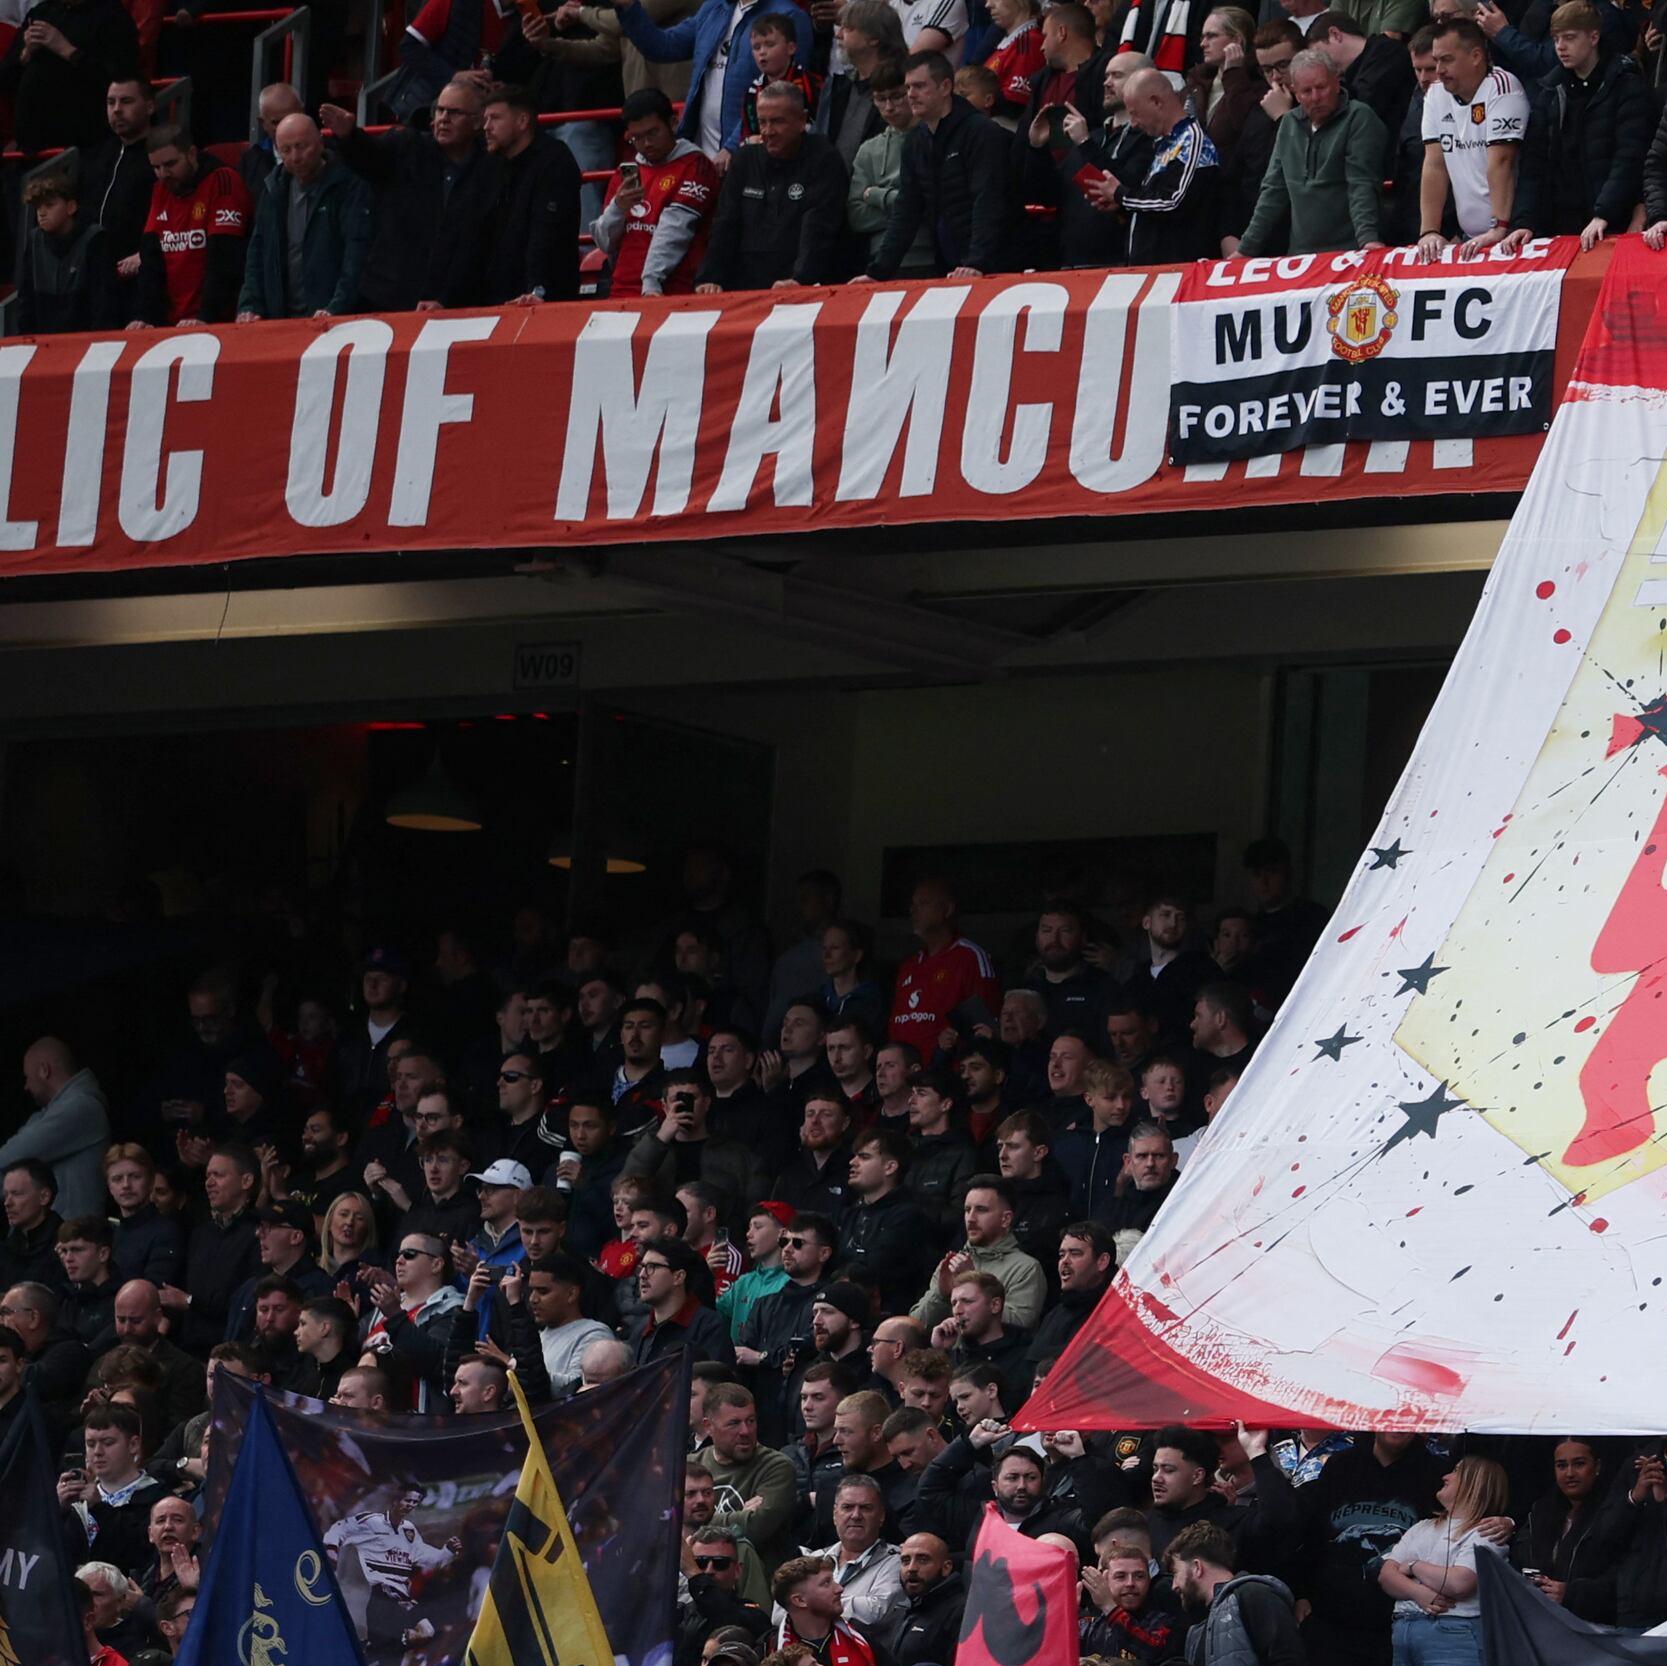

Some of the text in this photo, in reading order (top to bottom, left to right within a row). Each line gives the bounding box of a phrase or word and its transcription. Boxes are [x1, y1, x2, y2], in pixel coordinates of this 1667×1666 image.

[1215, 303, 1312, 365] MU
[1411, 287, 1493, 342] FC
[285, 317, 500, 528] OF
[1180, 375, 1533, 439] FOREVER & EVER
